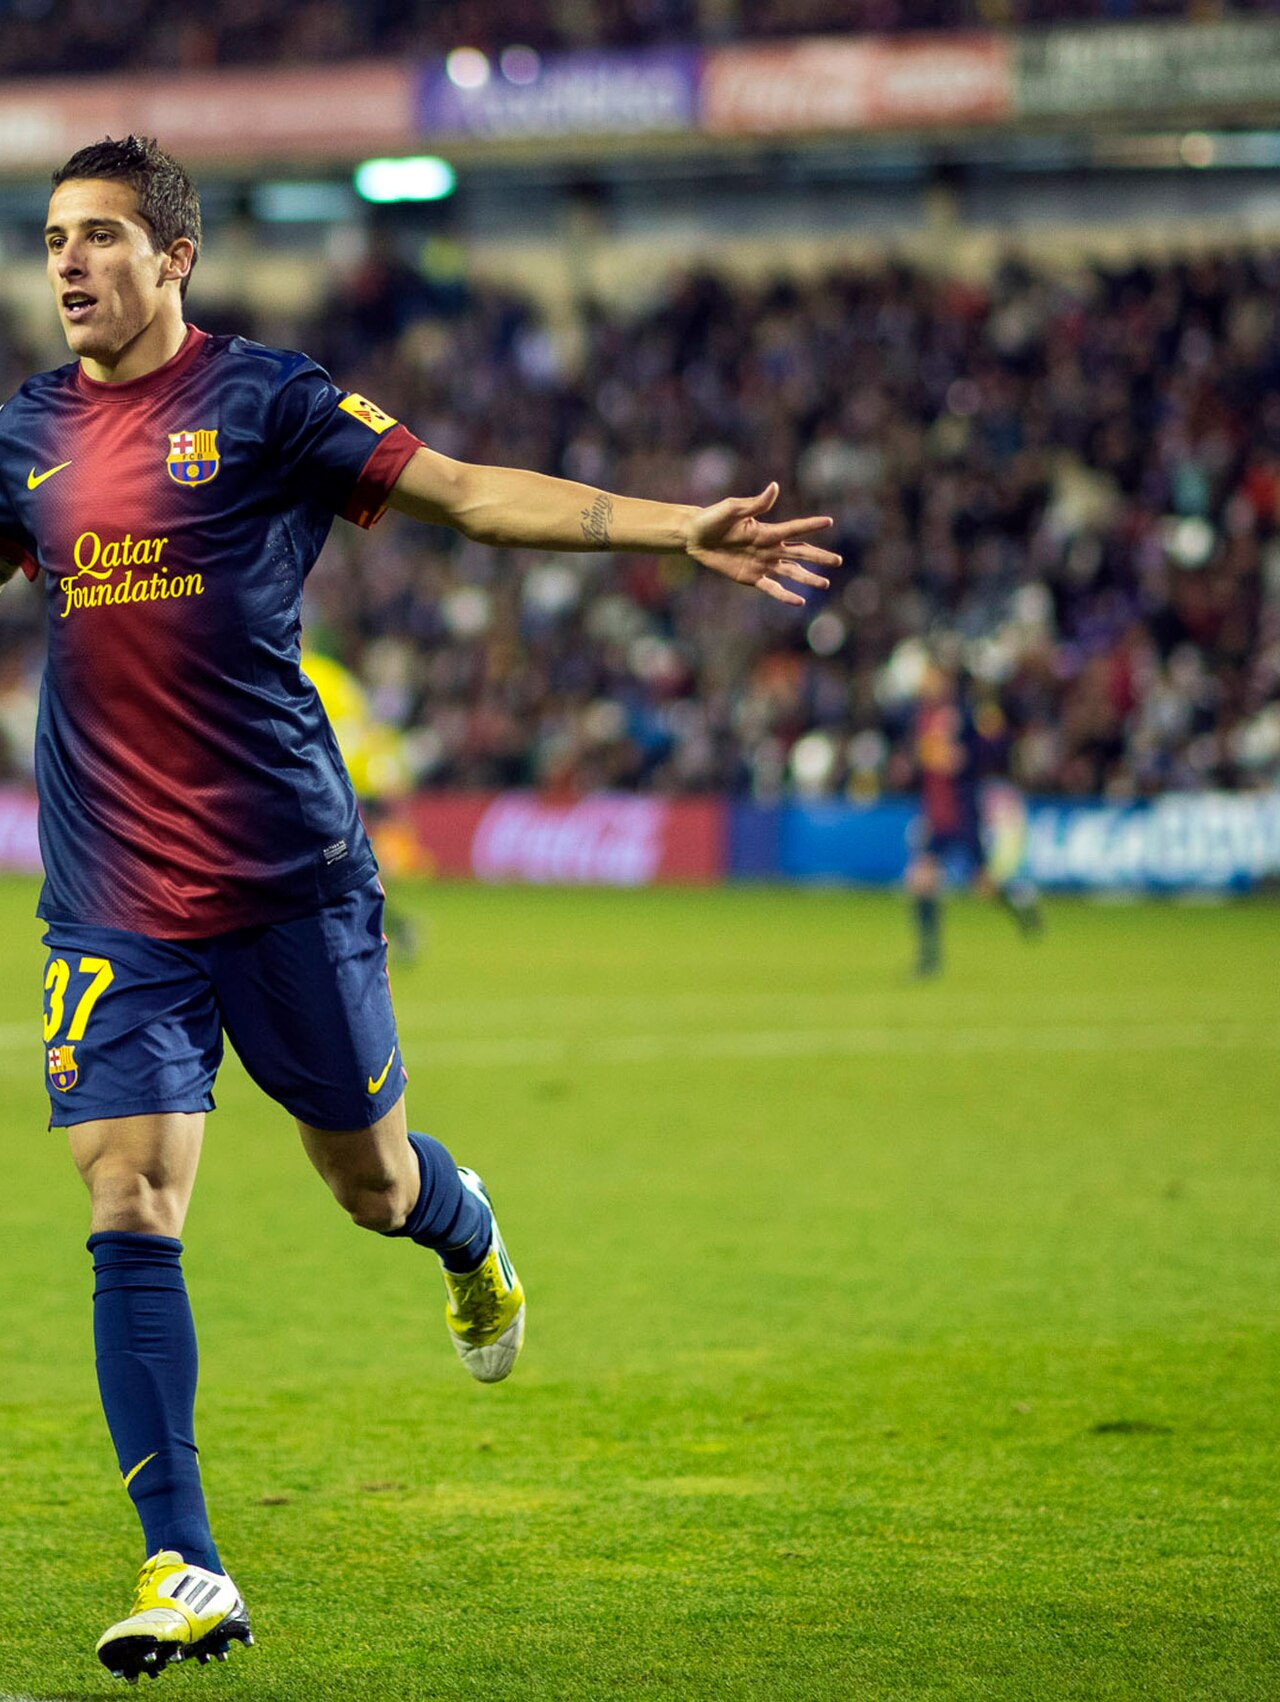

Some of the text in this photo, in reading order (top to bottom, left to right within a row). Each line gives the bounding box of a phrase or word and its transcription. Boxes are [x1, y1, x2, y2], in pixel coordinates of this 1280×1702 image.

[73, 531, 169, 580] Qatar
[60, 567, 205, 617] Foundation
[43, 956, 115, 1043] 37
